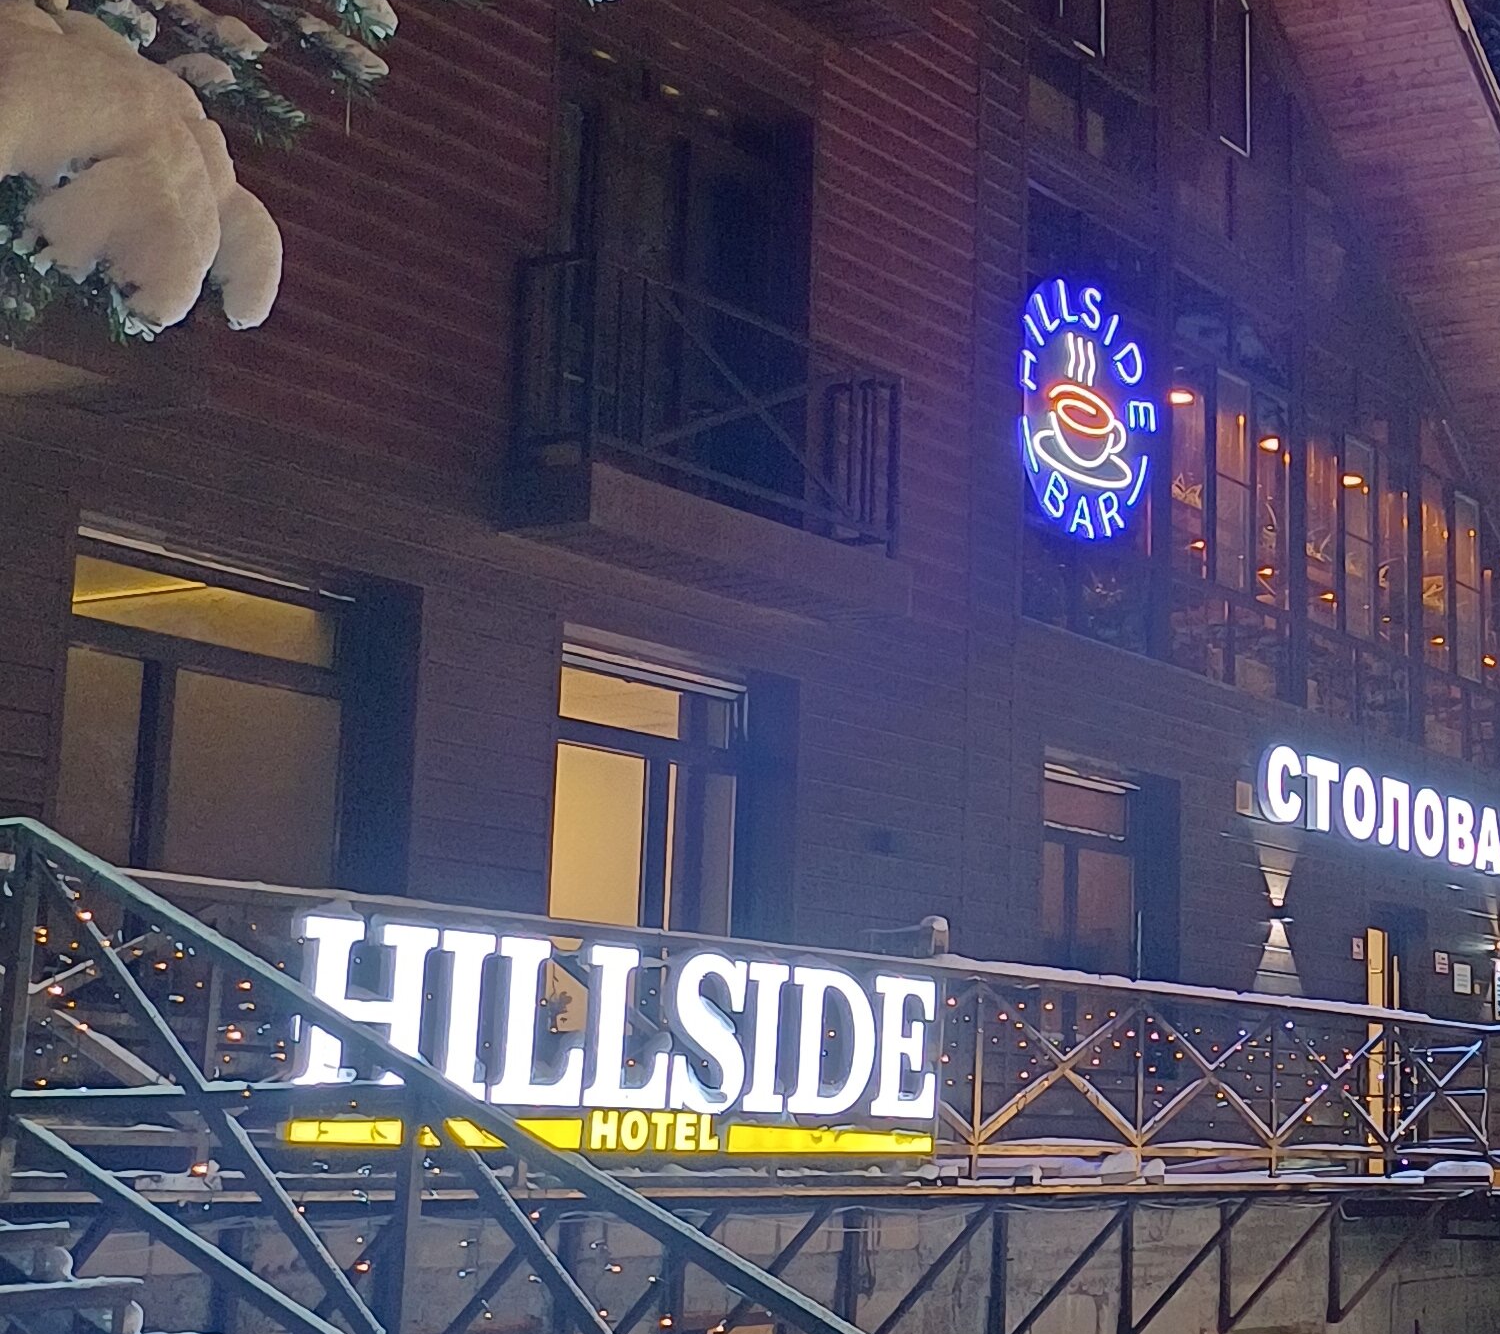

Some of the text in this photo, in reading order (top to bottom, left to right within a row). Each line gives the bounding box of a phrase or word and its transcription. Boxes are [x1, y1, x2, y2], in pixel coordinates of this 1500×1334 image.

[1042, 469, 1125, 539] BAR
[295, 915, 937, 1119] HILLSIDE
[588, 1109, 720, 1153] HOTEL
